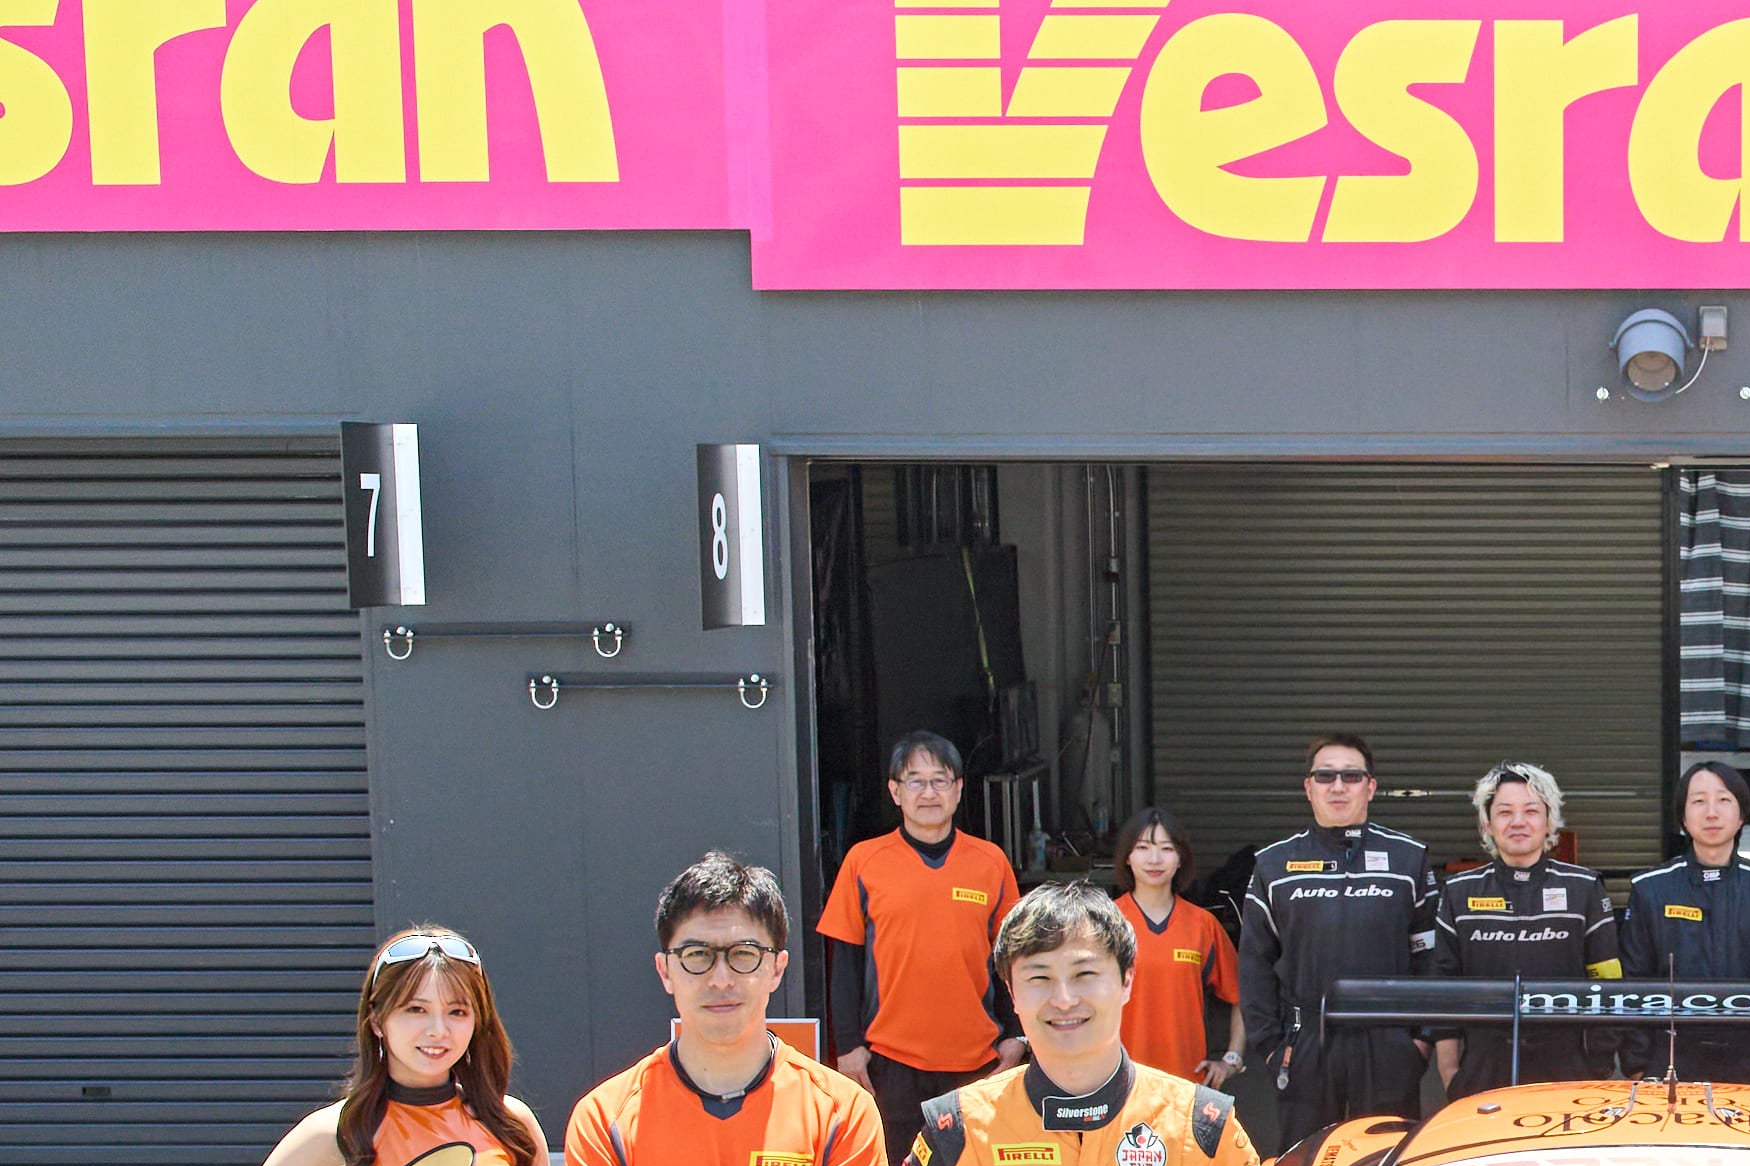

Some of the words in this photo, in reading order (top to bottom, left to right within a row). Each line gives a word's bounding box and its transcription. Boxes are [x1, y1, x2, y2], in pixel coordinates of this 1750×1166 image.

[359, 473, 382, 558] 7
[711, 493, 729, 581] 8
[1290, 886, 1339, 900] Auto
[1344, 884, 1394, 898] Labo
[1470, 929, 1514, 942] Auto
[1518, 927, 1570, 942] Labo
[1056, 1103, 1109, 1119] Silverstone
[997, 1147, 1054, 1161] PIRELLI
[1122, 1149, 1163, 1163] JAPAN
